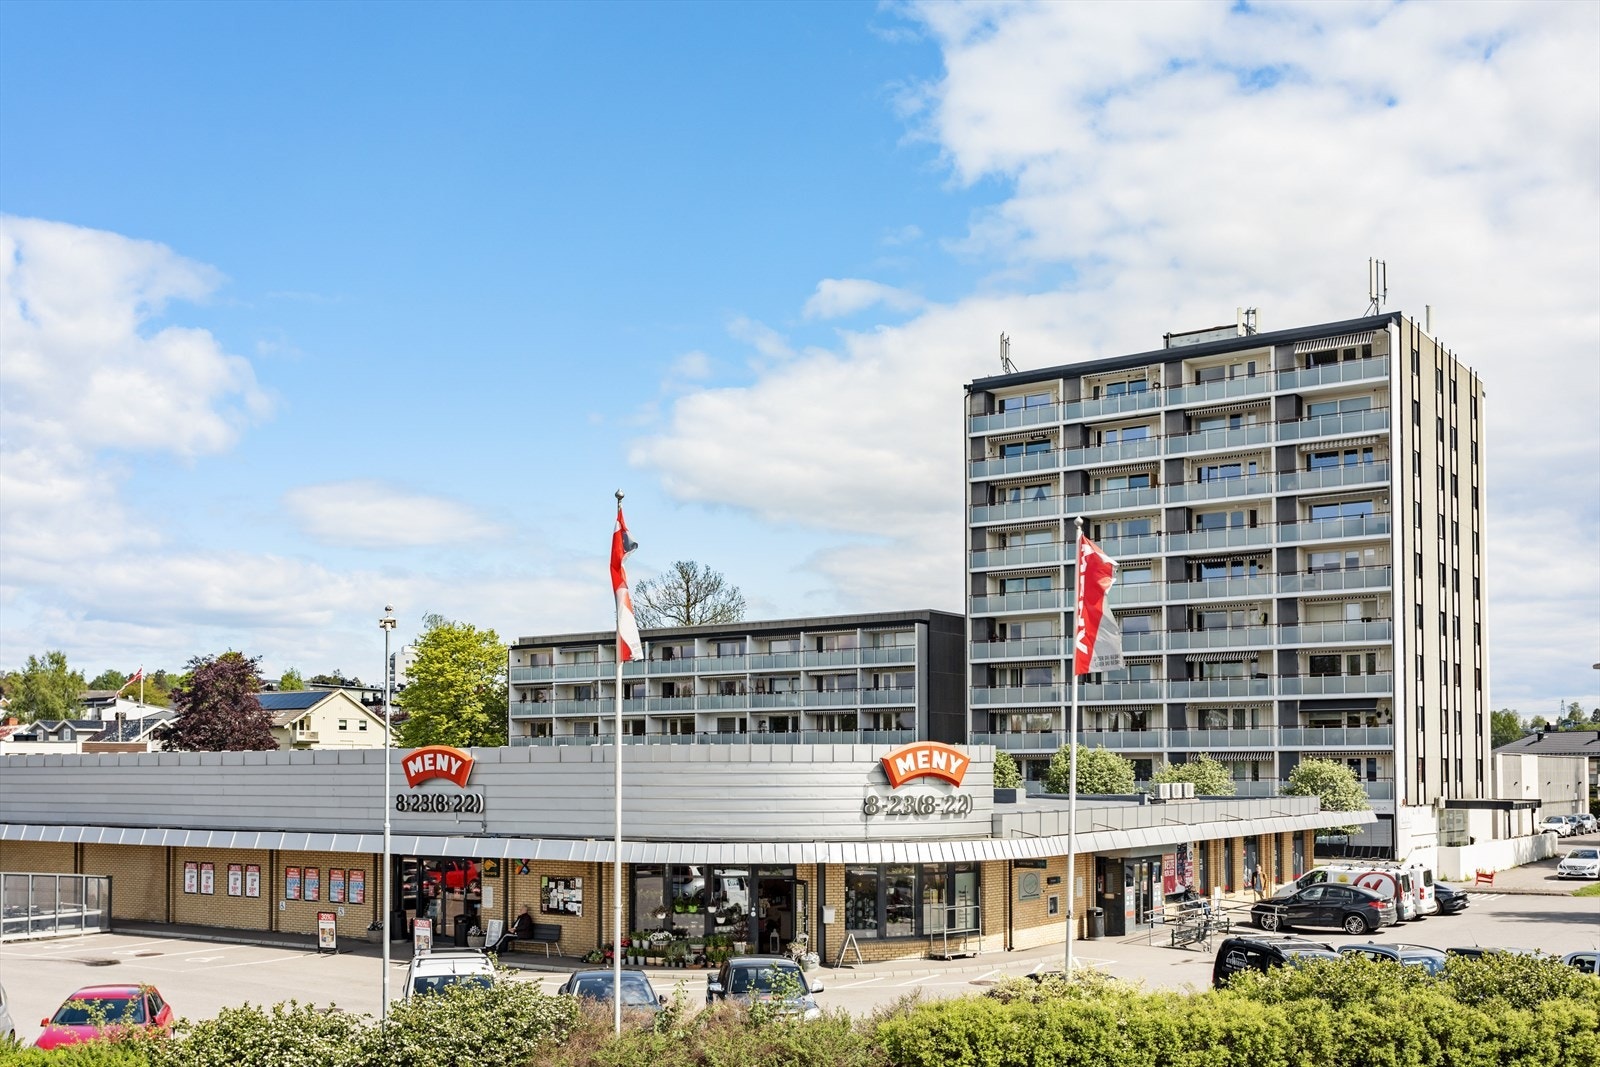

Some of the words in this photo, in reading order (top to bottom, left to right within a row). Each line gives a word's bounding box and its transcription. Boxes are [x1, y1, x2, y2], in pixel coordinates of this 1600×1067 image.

[407, 753, 463, 777] MENY
[895, 750, 963, 777] MENY
[864, 793, 974, 816] 8-23(8-22)
